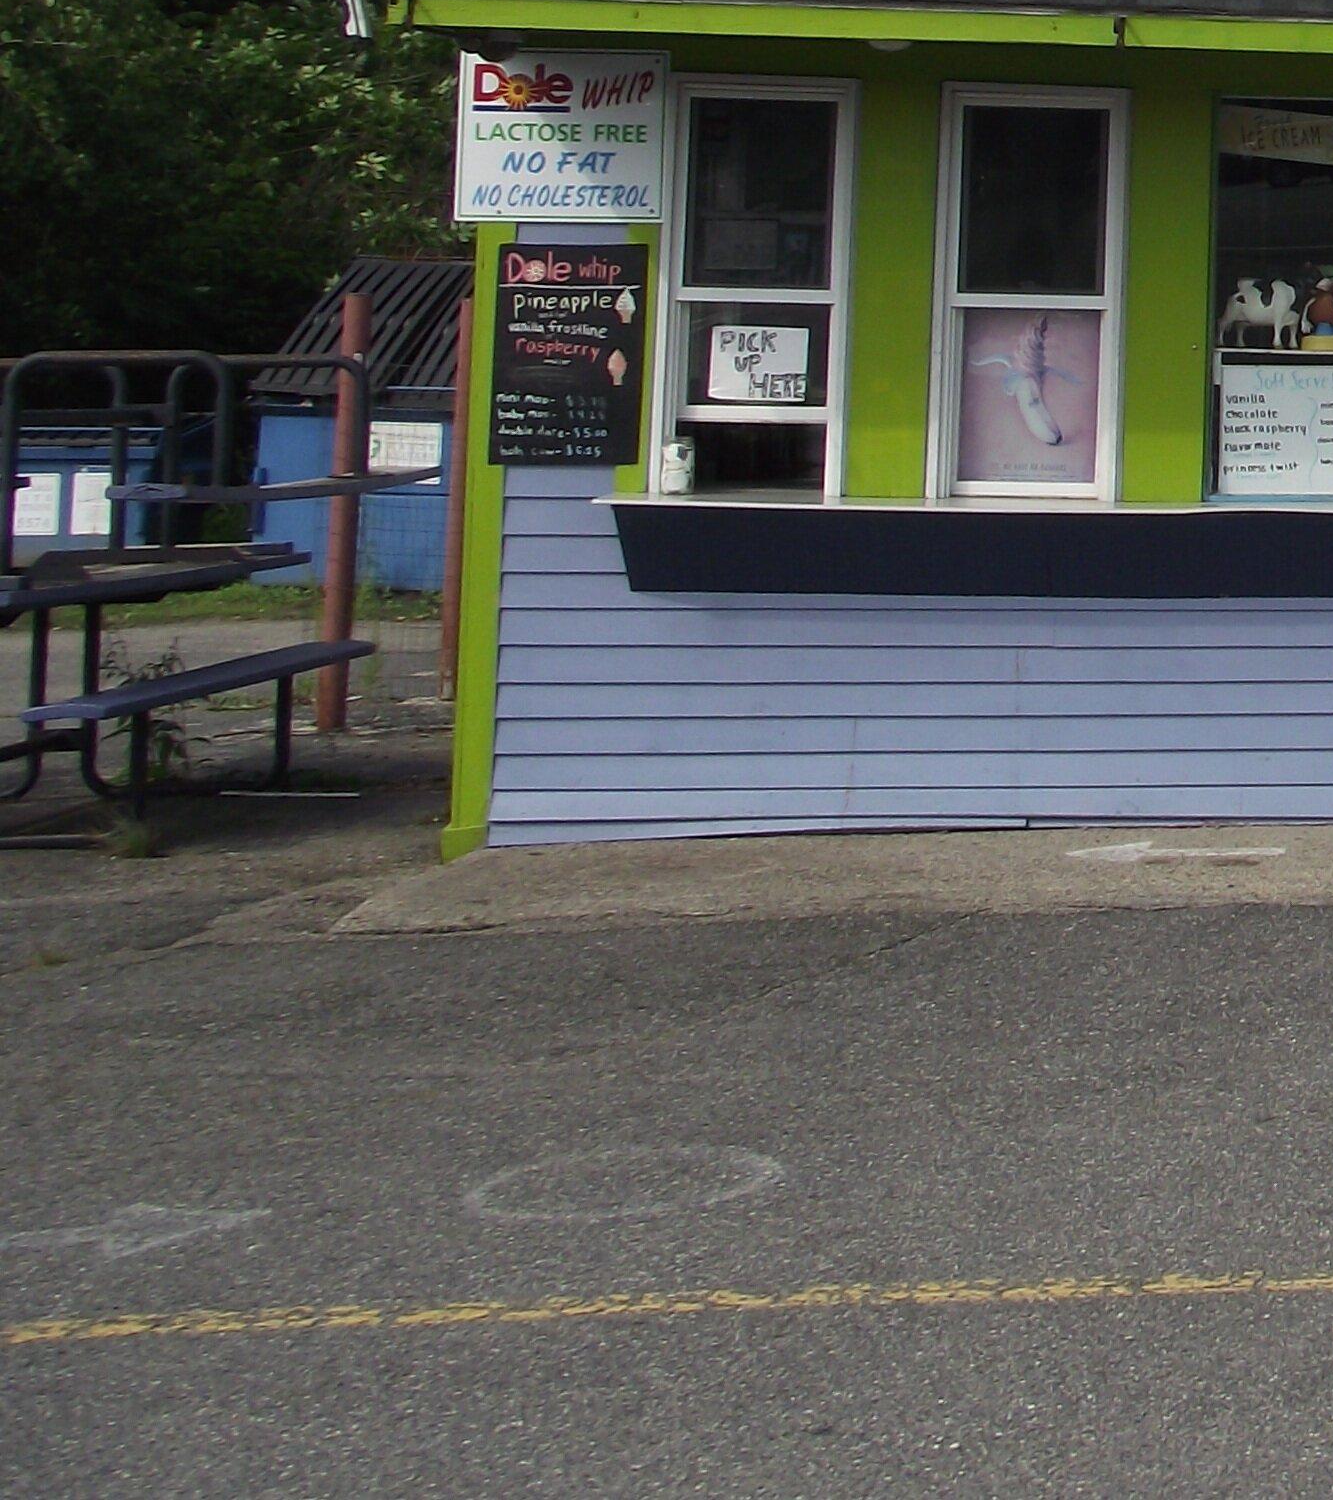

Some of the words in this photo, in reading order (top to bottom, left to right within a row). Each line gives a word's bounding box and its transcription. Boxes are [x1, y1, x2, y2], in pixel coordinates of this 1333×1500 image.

[473, 63, 574, 108] Dole
[582, 71, 655, 109] WHIP
[475, 123, 582, 143] LACTOSE
[594, 124, 648, 143] FREE
[1272, 125, 1321, 149] CREAM
[502, 151, 546, 174] NO
[557, 152, 616, 175] FAT
[472, 184, 502, 207] NO
[507, 184, 649, 208] CHOLESTEROL
[507, 251, 572, 283] Dole
[579, 255, 621, 284] whip
[514, 290, 613, 319] pineapple
[515, 337, 600, 363] raspberry
[720, 330, 778, 353] PICK
[734, 354, 761, 372] UP
[749, 373, 807, 398] HERE
[1225, 394, 1266, 404] vanilla
[1253, 424, 1307, 436] raspberry
